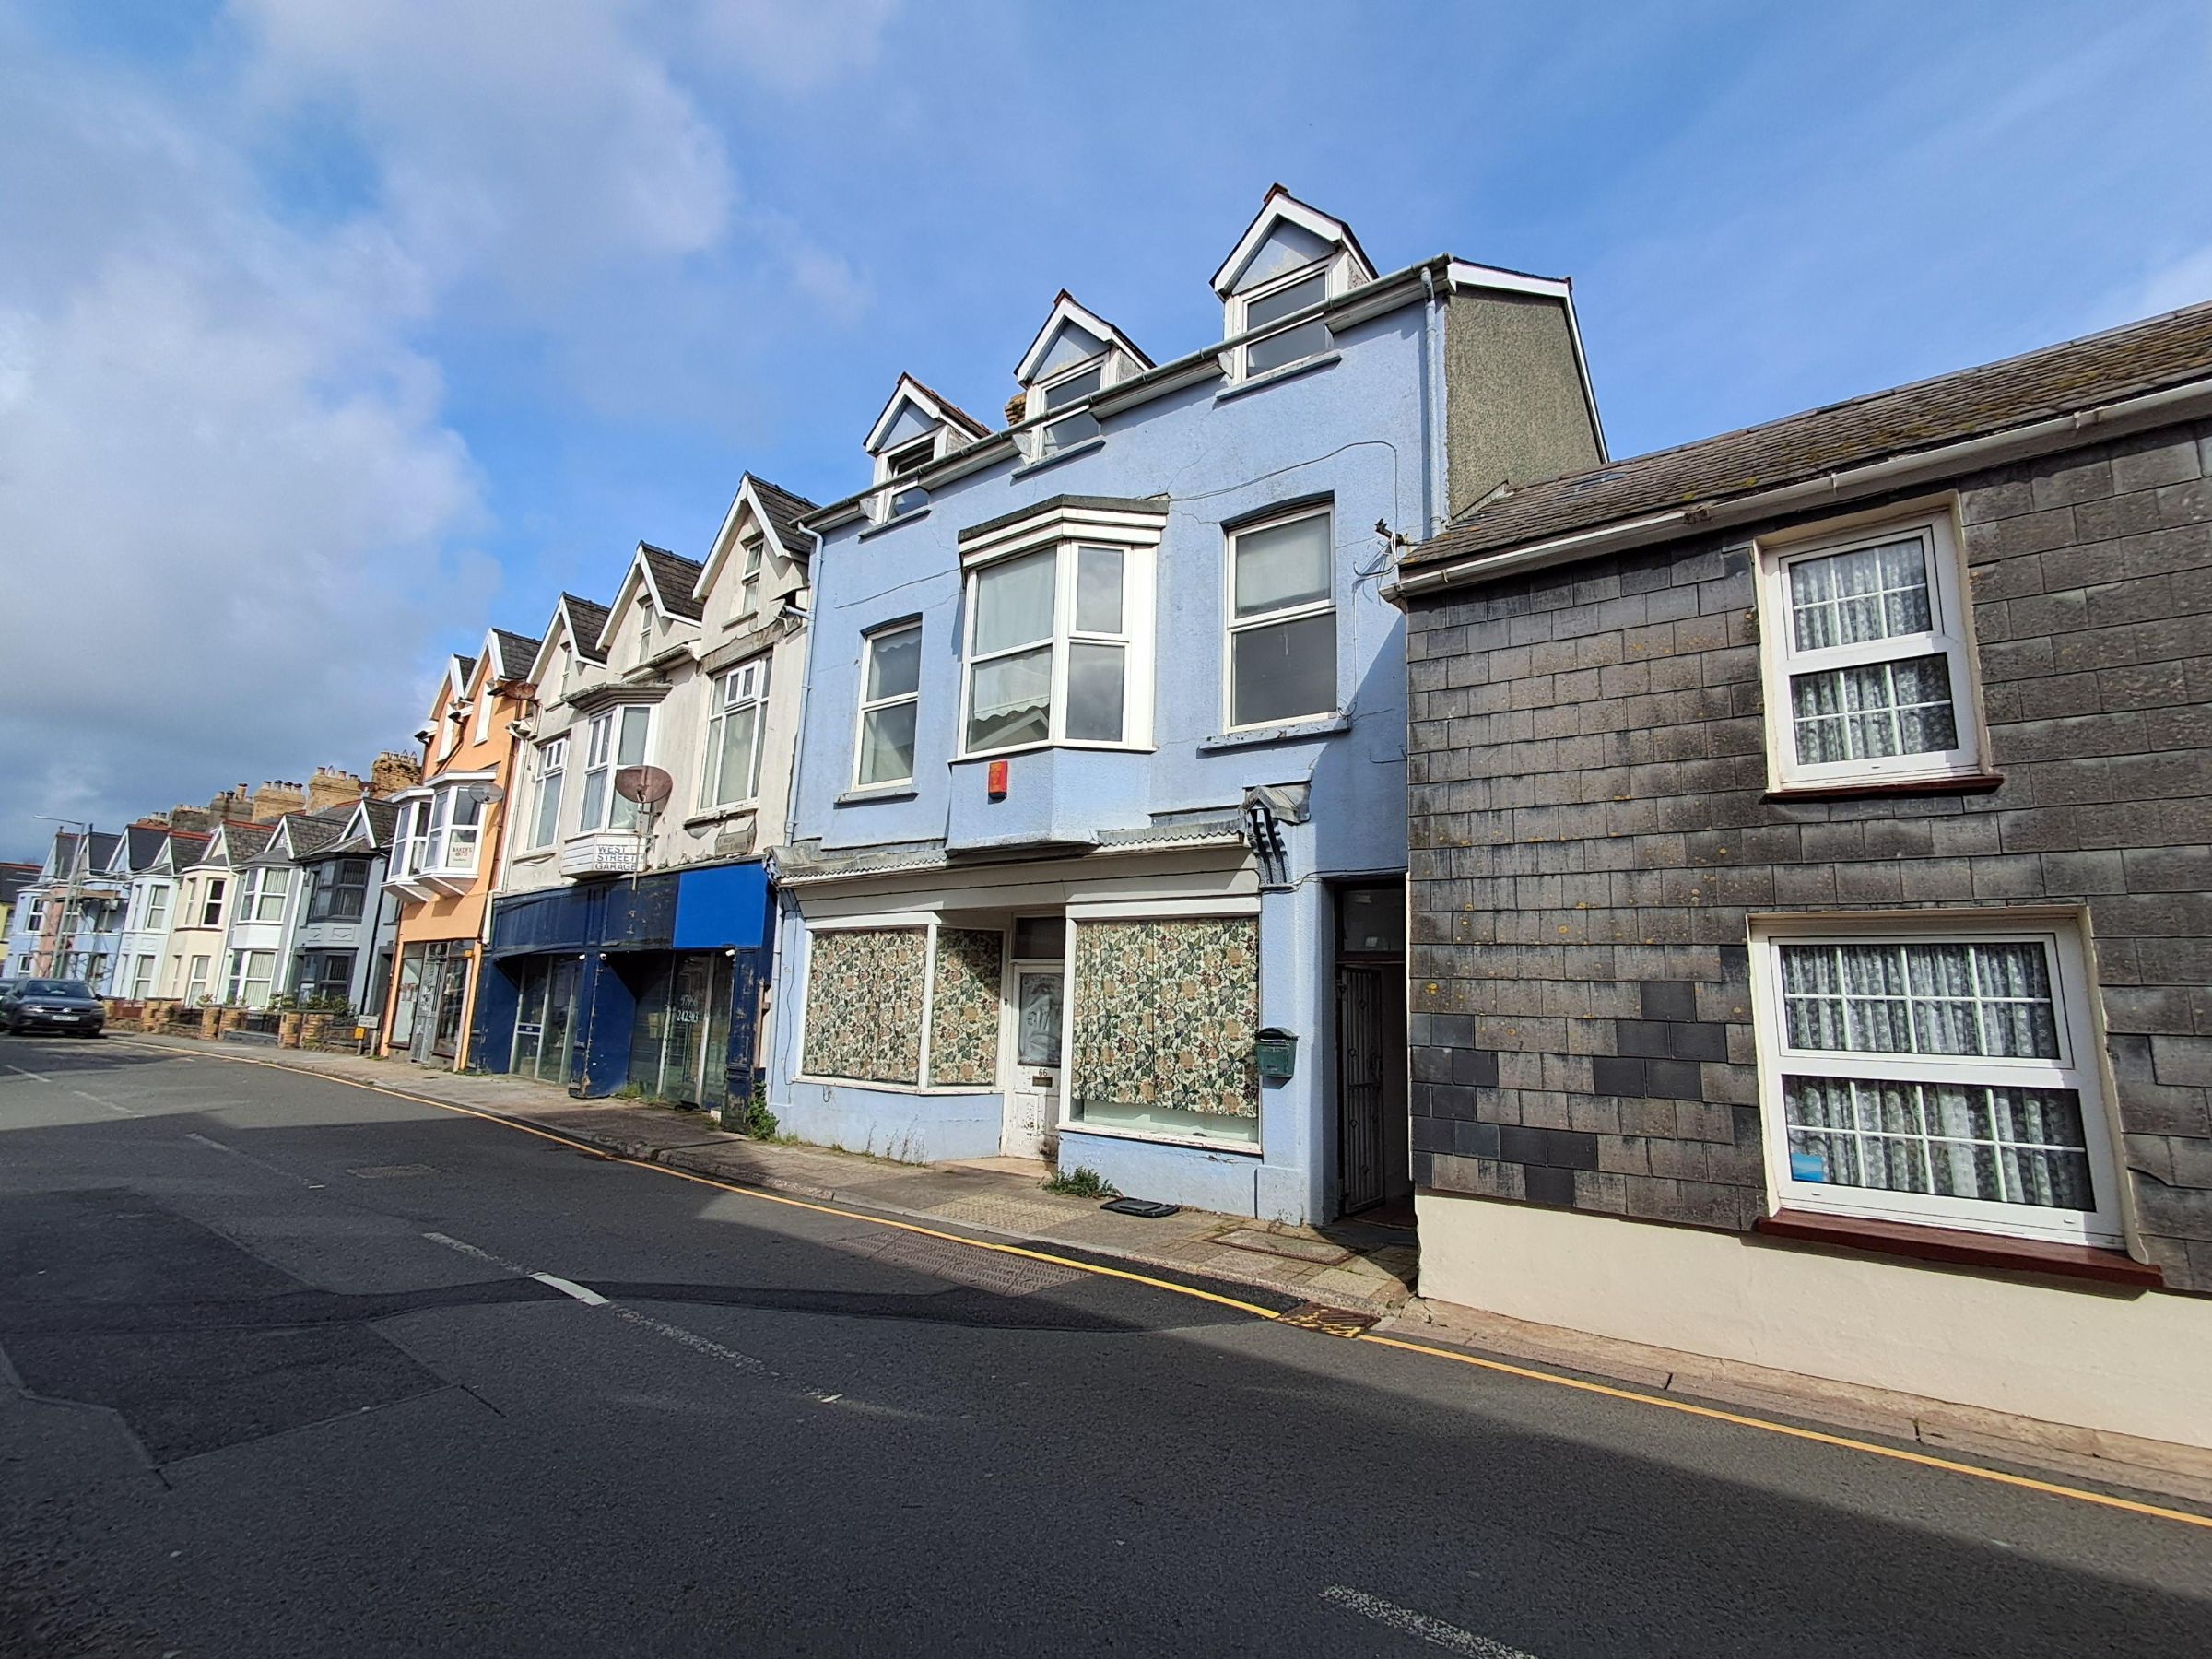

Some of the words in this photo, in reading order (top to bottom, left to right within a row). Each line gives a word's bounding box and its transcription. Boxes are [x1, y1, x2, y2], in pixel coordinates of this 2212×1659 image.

[597, 845, 626, 853] WEST
[596, 853, 636, 862] STREET
[594, 863, 638, 871] GARAGE
[1038, 1068, 1048, 1077] 66
